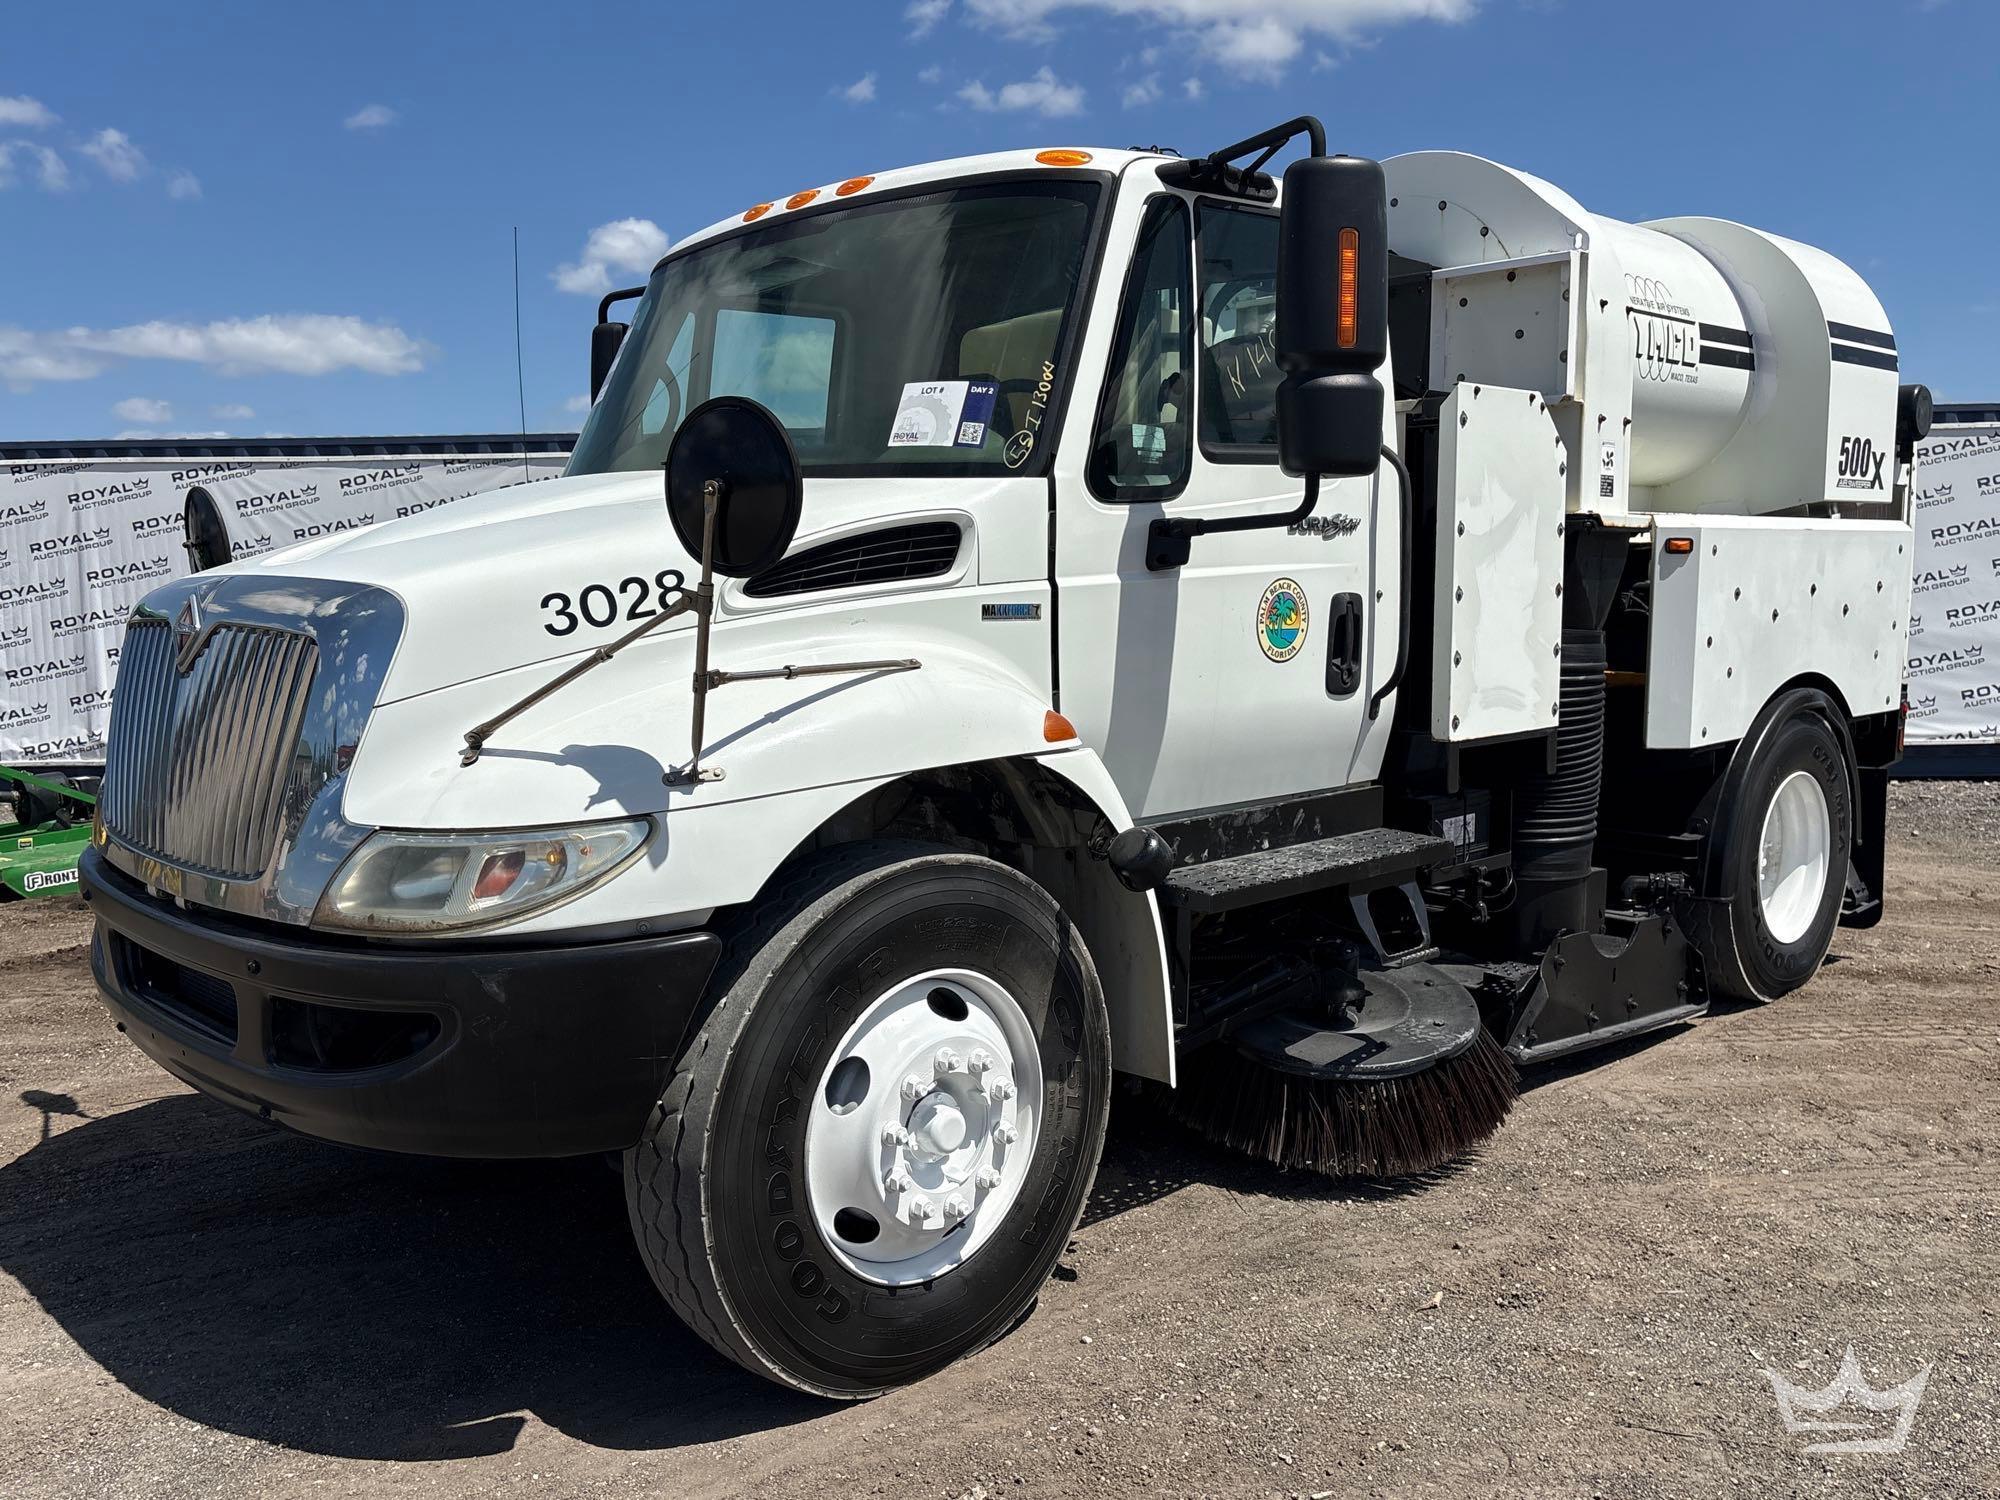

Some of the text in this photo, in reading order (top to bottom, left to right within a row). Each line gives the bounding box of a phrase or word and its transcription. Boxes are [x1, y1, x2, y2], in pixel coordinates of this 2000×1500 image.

[921, 386, 945, 395] LOT #
[970, 386, 994, 395] DAY 2
[893, 432, 919, 440] ROYAL
[1917, 436, 1988, 459] ROYAL
[1919, 444, 2000, 467] AUCTION GROU
[14, 469, 58, 484] AUCTION
[171, 462, 237, 482] ROYAL
[446, 461, 490, 475] AUCTION
[174, 469, 257, 491] AUCTION GROUP
[339, 468, 404, 489] ROYAL
[342, 475, 424, 497] AUCTION GROUP
[68, 483, 133, 504] ROYAL
[72, 490, 152, 512] AUCTION GROUP
[236, 489, 302, 511] ROYAL
[1916, 496, 1955, 509] GROUP
[239, 496, 321, 519] AUCTION GROUP
[14, 512, 49, 525] GROUP
[132, 513, 185, 532] ROYA
[136, 525, 181, 540] AUCTION
[293, 518, 359, 540] ROYAL
[29, 532, 94, 553] ROYAL
[33, 539, 114, 561] AUCTION GROUP
[1934, 533, 1983, 548] AUCTION
[86, 561, 153, 582] ROYAL
[89, 568, 172, 590] AUCTION GROUP
[1912, 570, 1950, 585] YAL
[0, 583, 50, 600] OYAL
[1931, 577, 1970, 591] GROUP
[34, 589, 69, 602] GROUP
[539, 568, 688, 637] 3028
[1259, 582, 1307, 625] PALM BEACH COUNTY
[1946, 600, 2000, 620] ROYA
[50, 609, 114, 631] ROYAL
[53, 617, 129, 639] AUCTION GROU
[1949, 614, 1998, 629] AUCTION
[1266, 645, 1297, 658] FLORIDA
[1908, 650, 1965, 669] OYAL
[5, 659, 70, 680] ROYAL
[1946, 657, 1985, 671] GROUP
[9, 666, 88, 688] AUCTION GROUP
[69, 689, 115, 707] ROY
[1961, 684, 2000, 700] ROY
[1964, 696, 2000, 709] AUCTI
[0, 708, 32, 722] YAL
[16, 714, 51, 727] GROUP
[1908, 708, 1939, 720] ROUP
[22, 736, 87, 756] ROYAL
[72, 742, 106, 754] GROUP
[765, 946, 897, 1324] GOODYEAR
